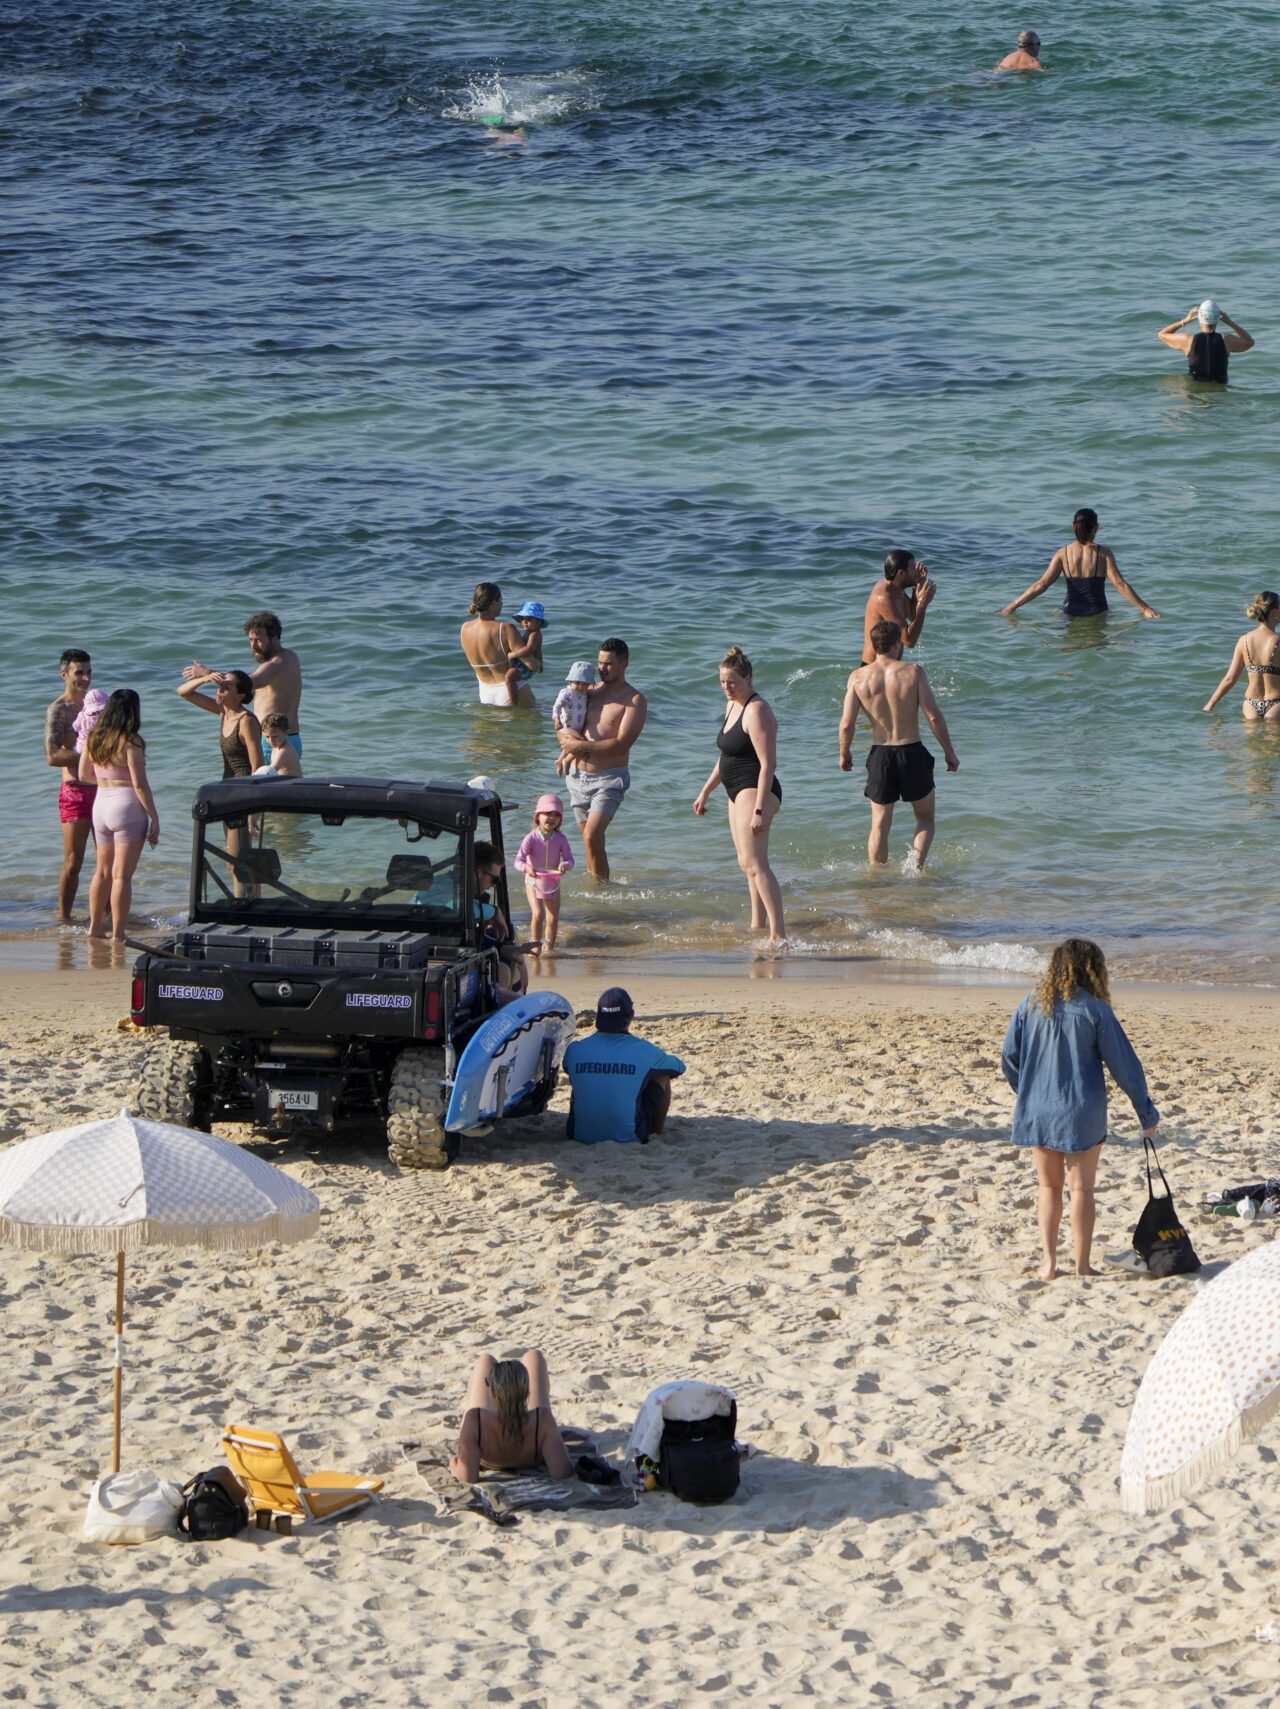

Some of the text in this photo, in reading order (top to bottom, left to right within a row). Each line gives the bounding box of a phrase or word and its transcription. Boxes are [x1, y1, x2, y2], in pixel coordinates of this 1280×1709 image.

[158, 985, 224, 1000] LIFEGUARD
[346, 993, 412, 1008] LIFEGUARD
[575, 1062, 636, 1075] LIFEGUARD
